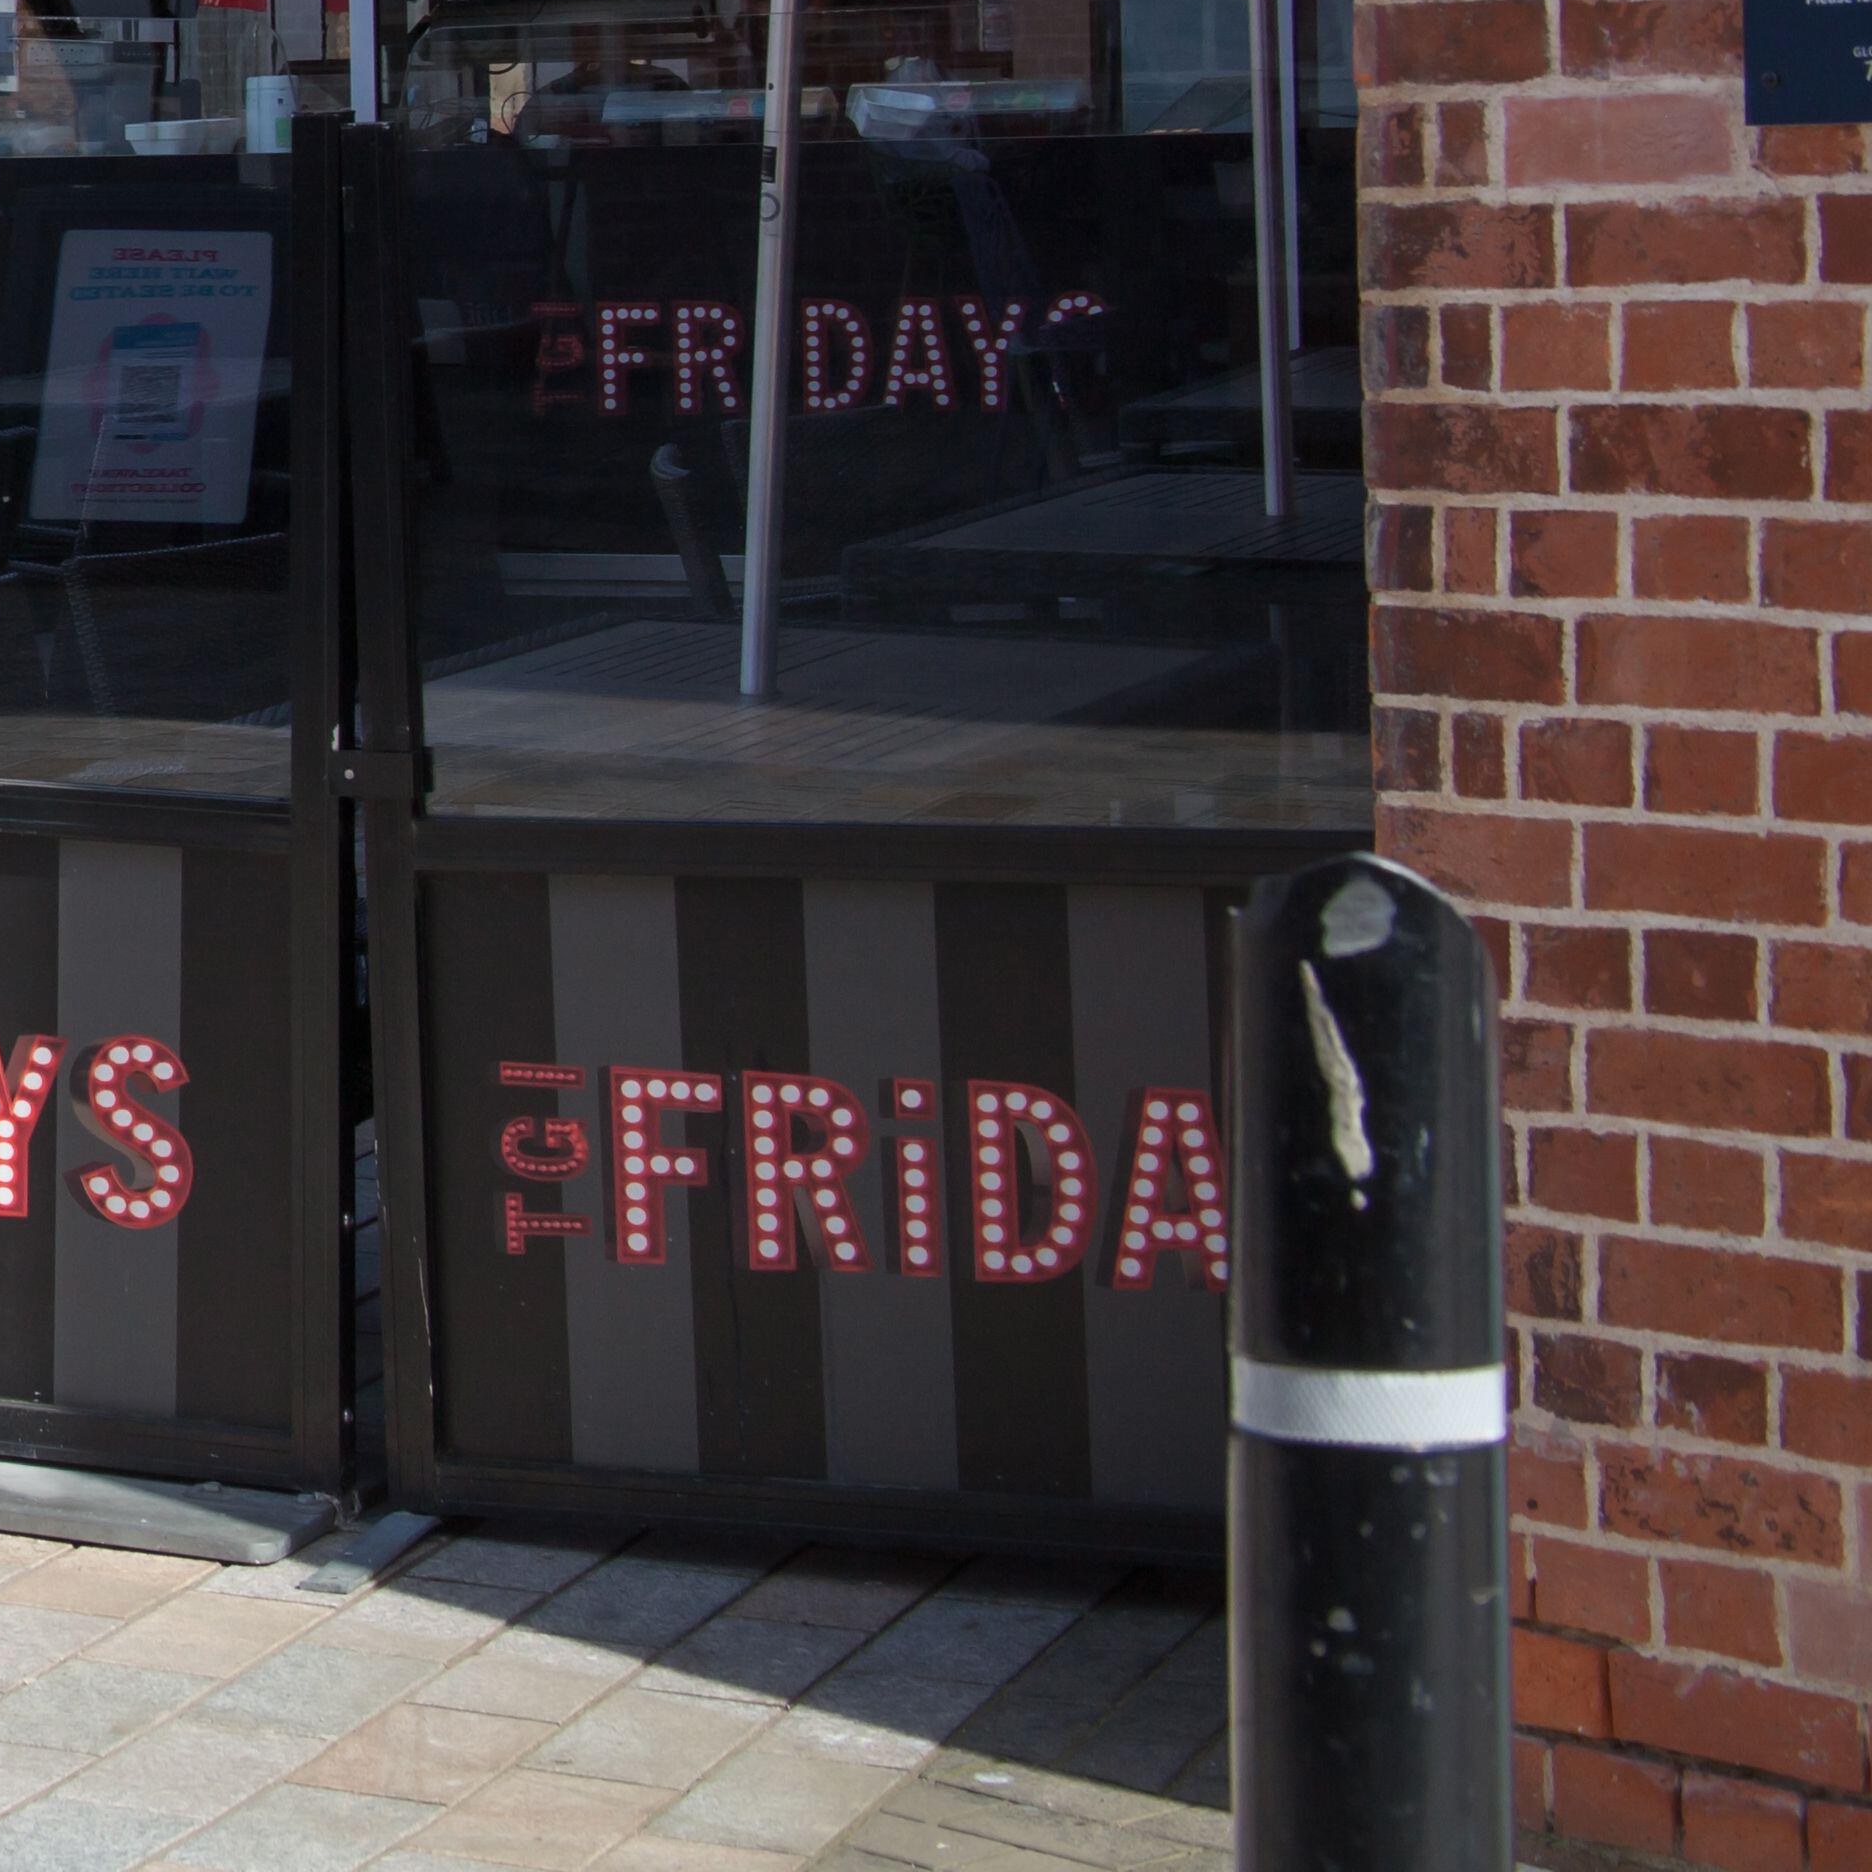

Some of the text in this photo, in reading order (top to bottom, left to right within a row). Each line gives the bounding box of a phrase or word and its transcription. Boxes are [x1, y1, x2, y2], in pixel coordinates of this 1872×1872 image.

[596, 290, 1108, 415] FRDAY
[498, 1061, 1229, 1292] TGI FRiDA
